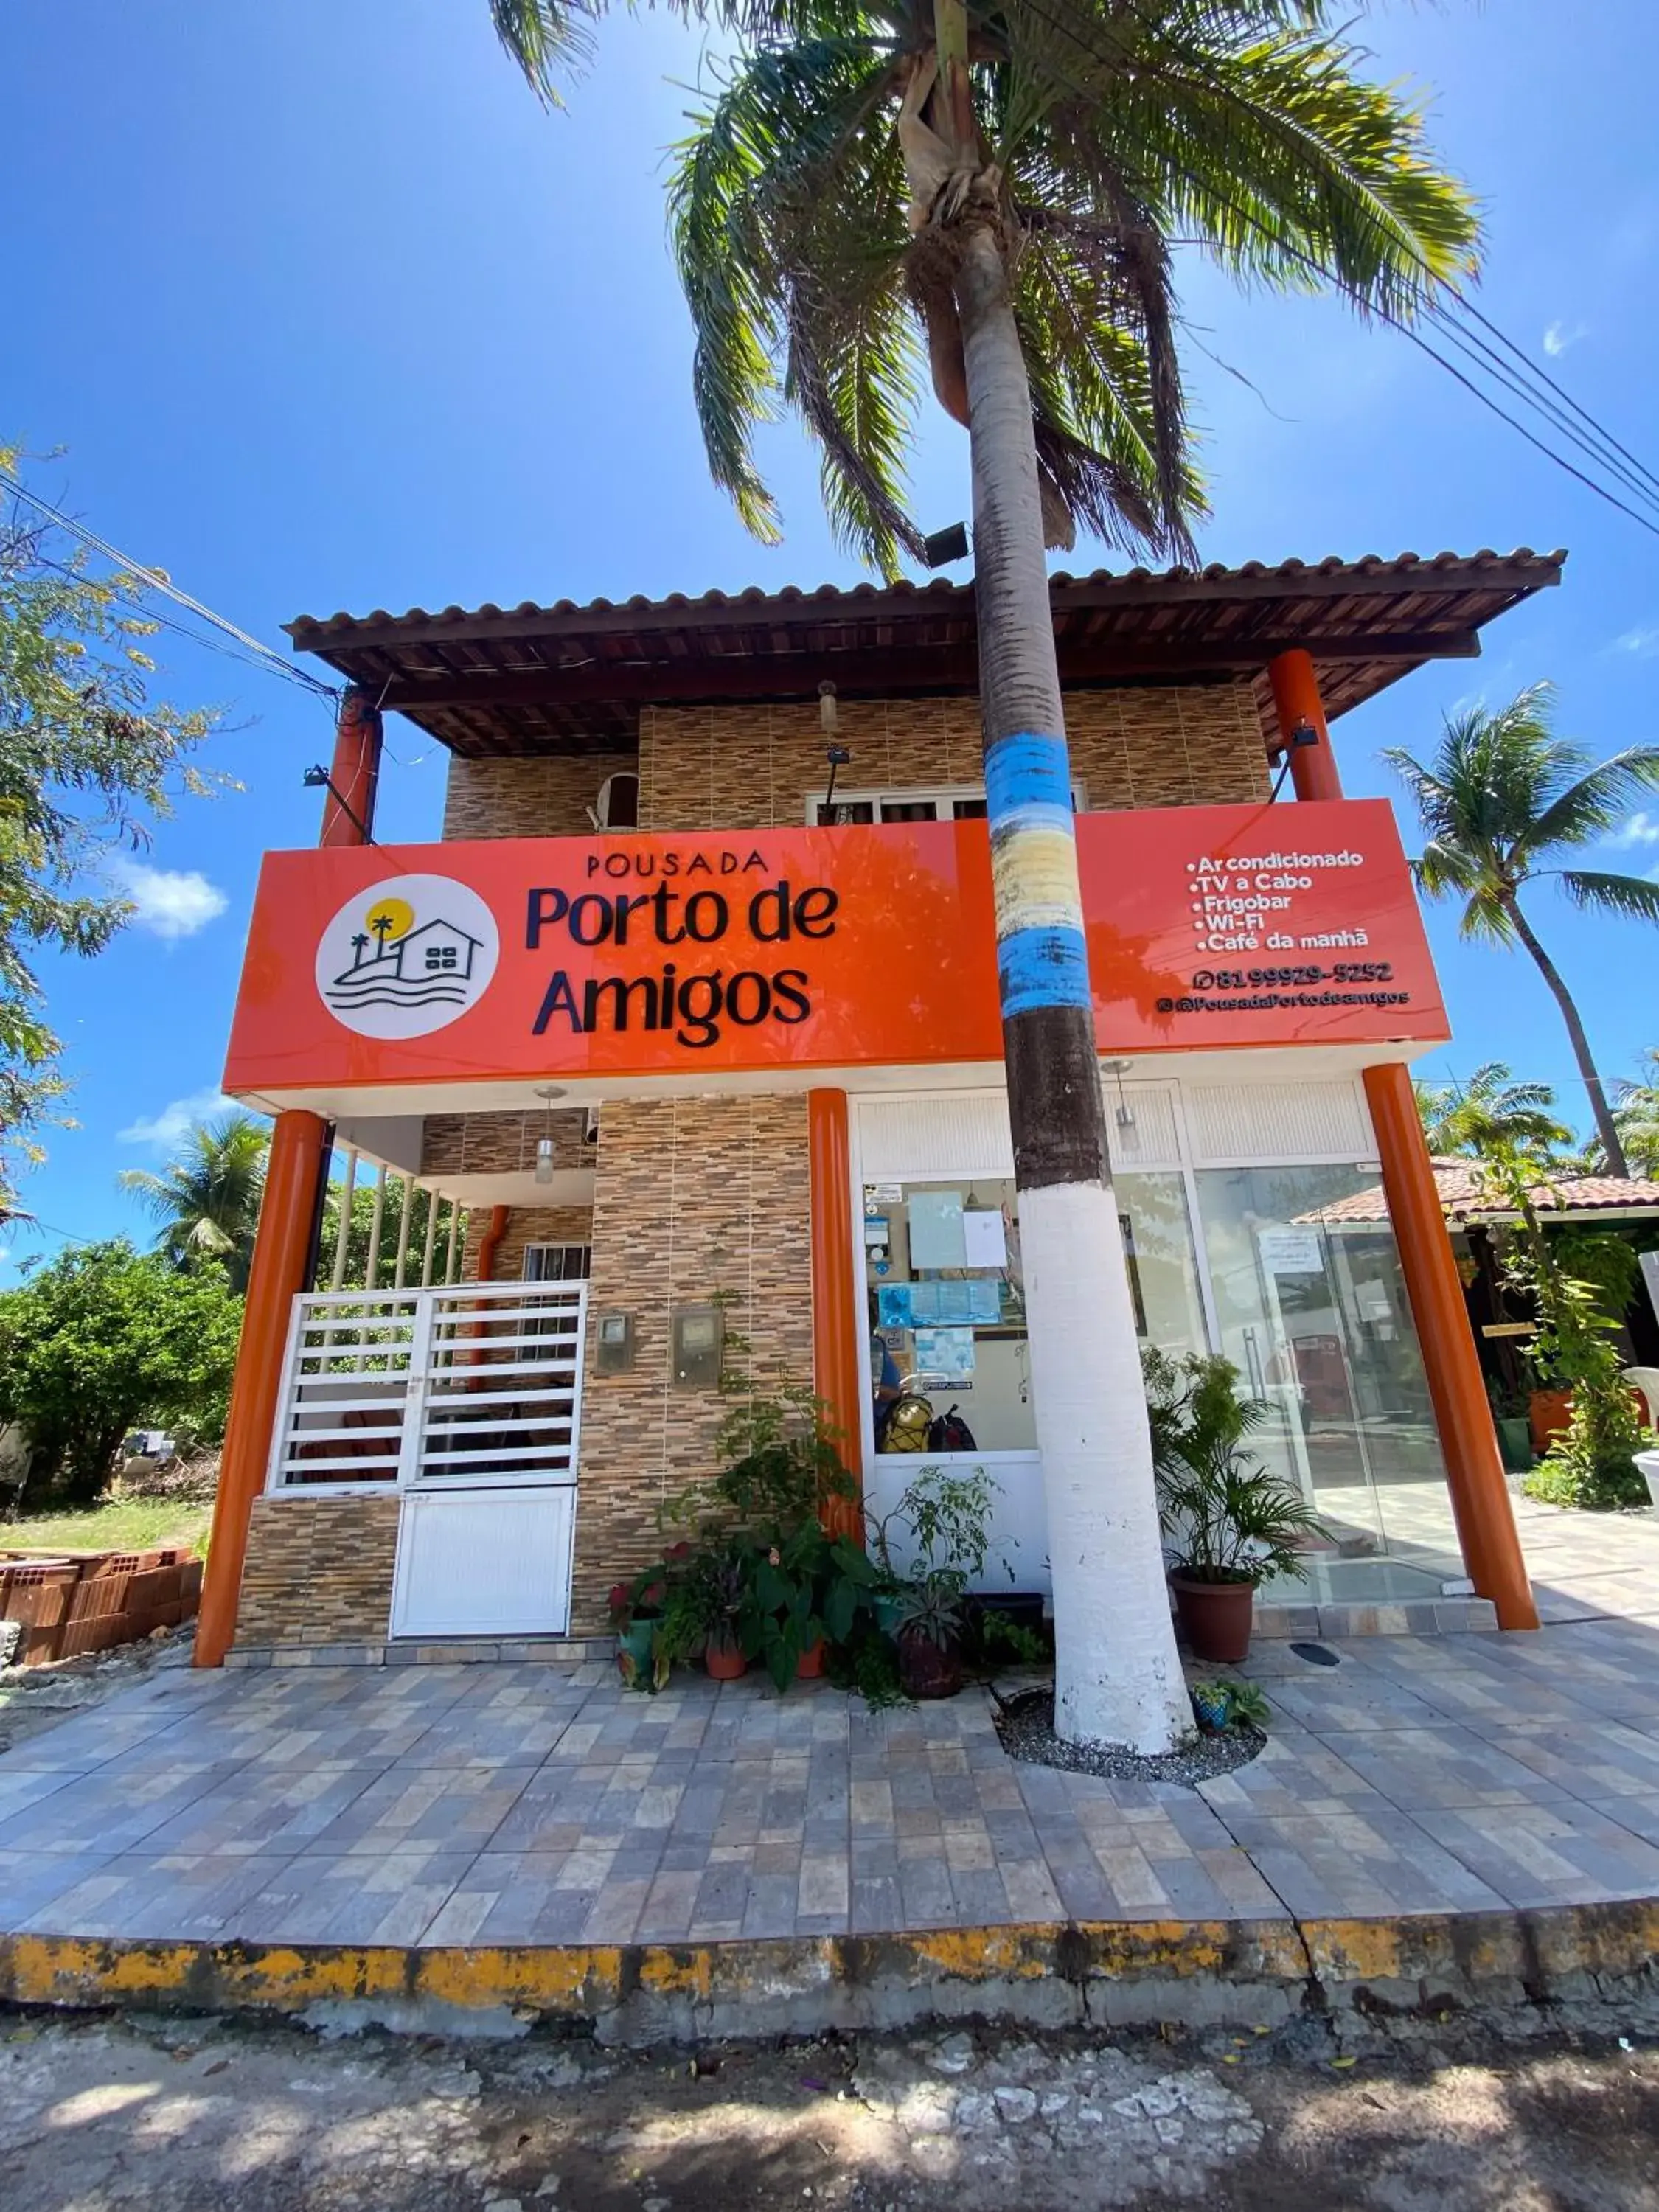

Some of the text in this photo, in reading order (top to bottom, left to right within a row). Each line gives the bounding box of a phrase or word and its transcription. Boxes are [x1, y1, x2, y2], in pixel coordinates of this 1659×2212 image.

[587, 849, 766, 878] POUSADA
[1197, 849, 1364, 874] Ar condicionado
[1196, 872, 1312, 893] TV a Cabo
[526, 880, 838, 950] Porto de
[1204, 893, 1291, 915] Frigobar
[1206, 913, 1265, 931] Wi-Fi
[1208, 927, 1368, 953] Café da manhã
[1217, 969, 1247, 990] 81
[532, 963, 810, 1048] Amigos
